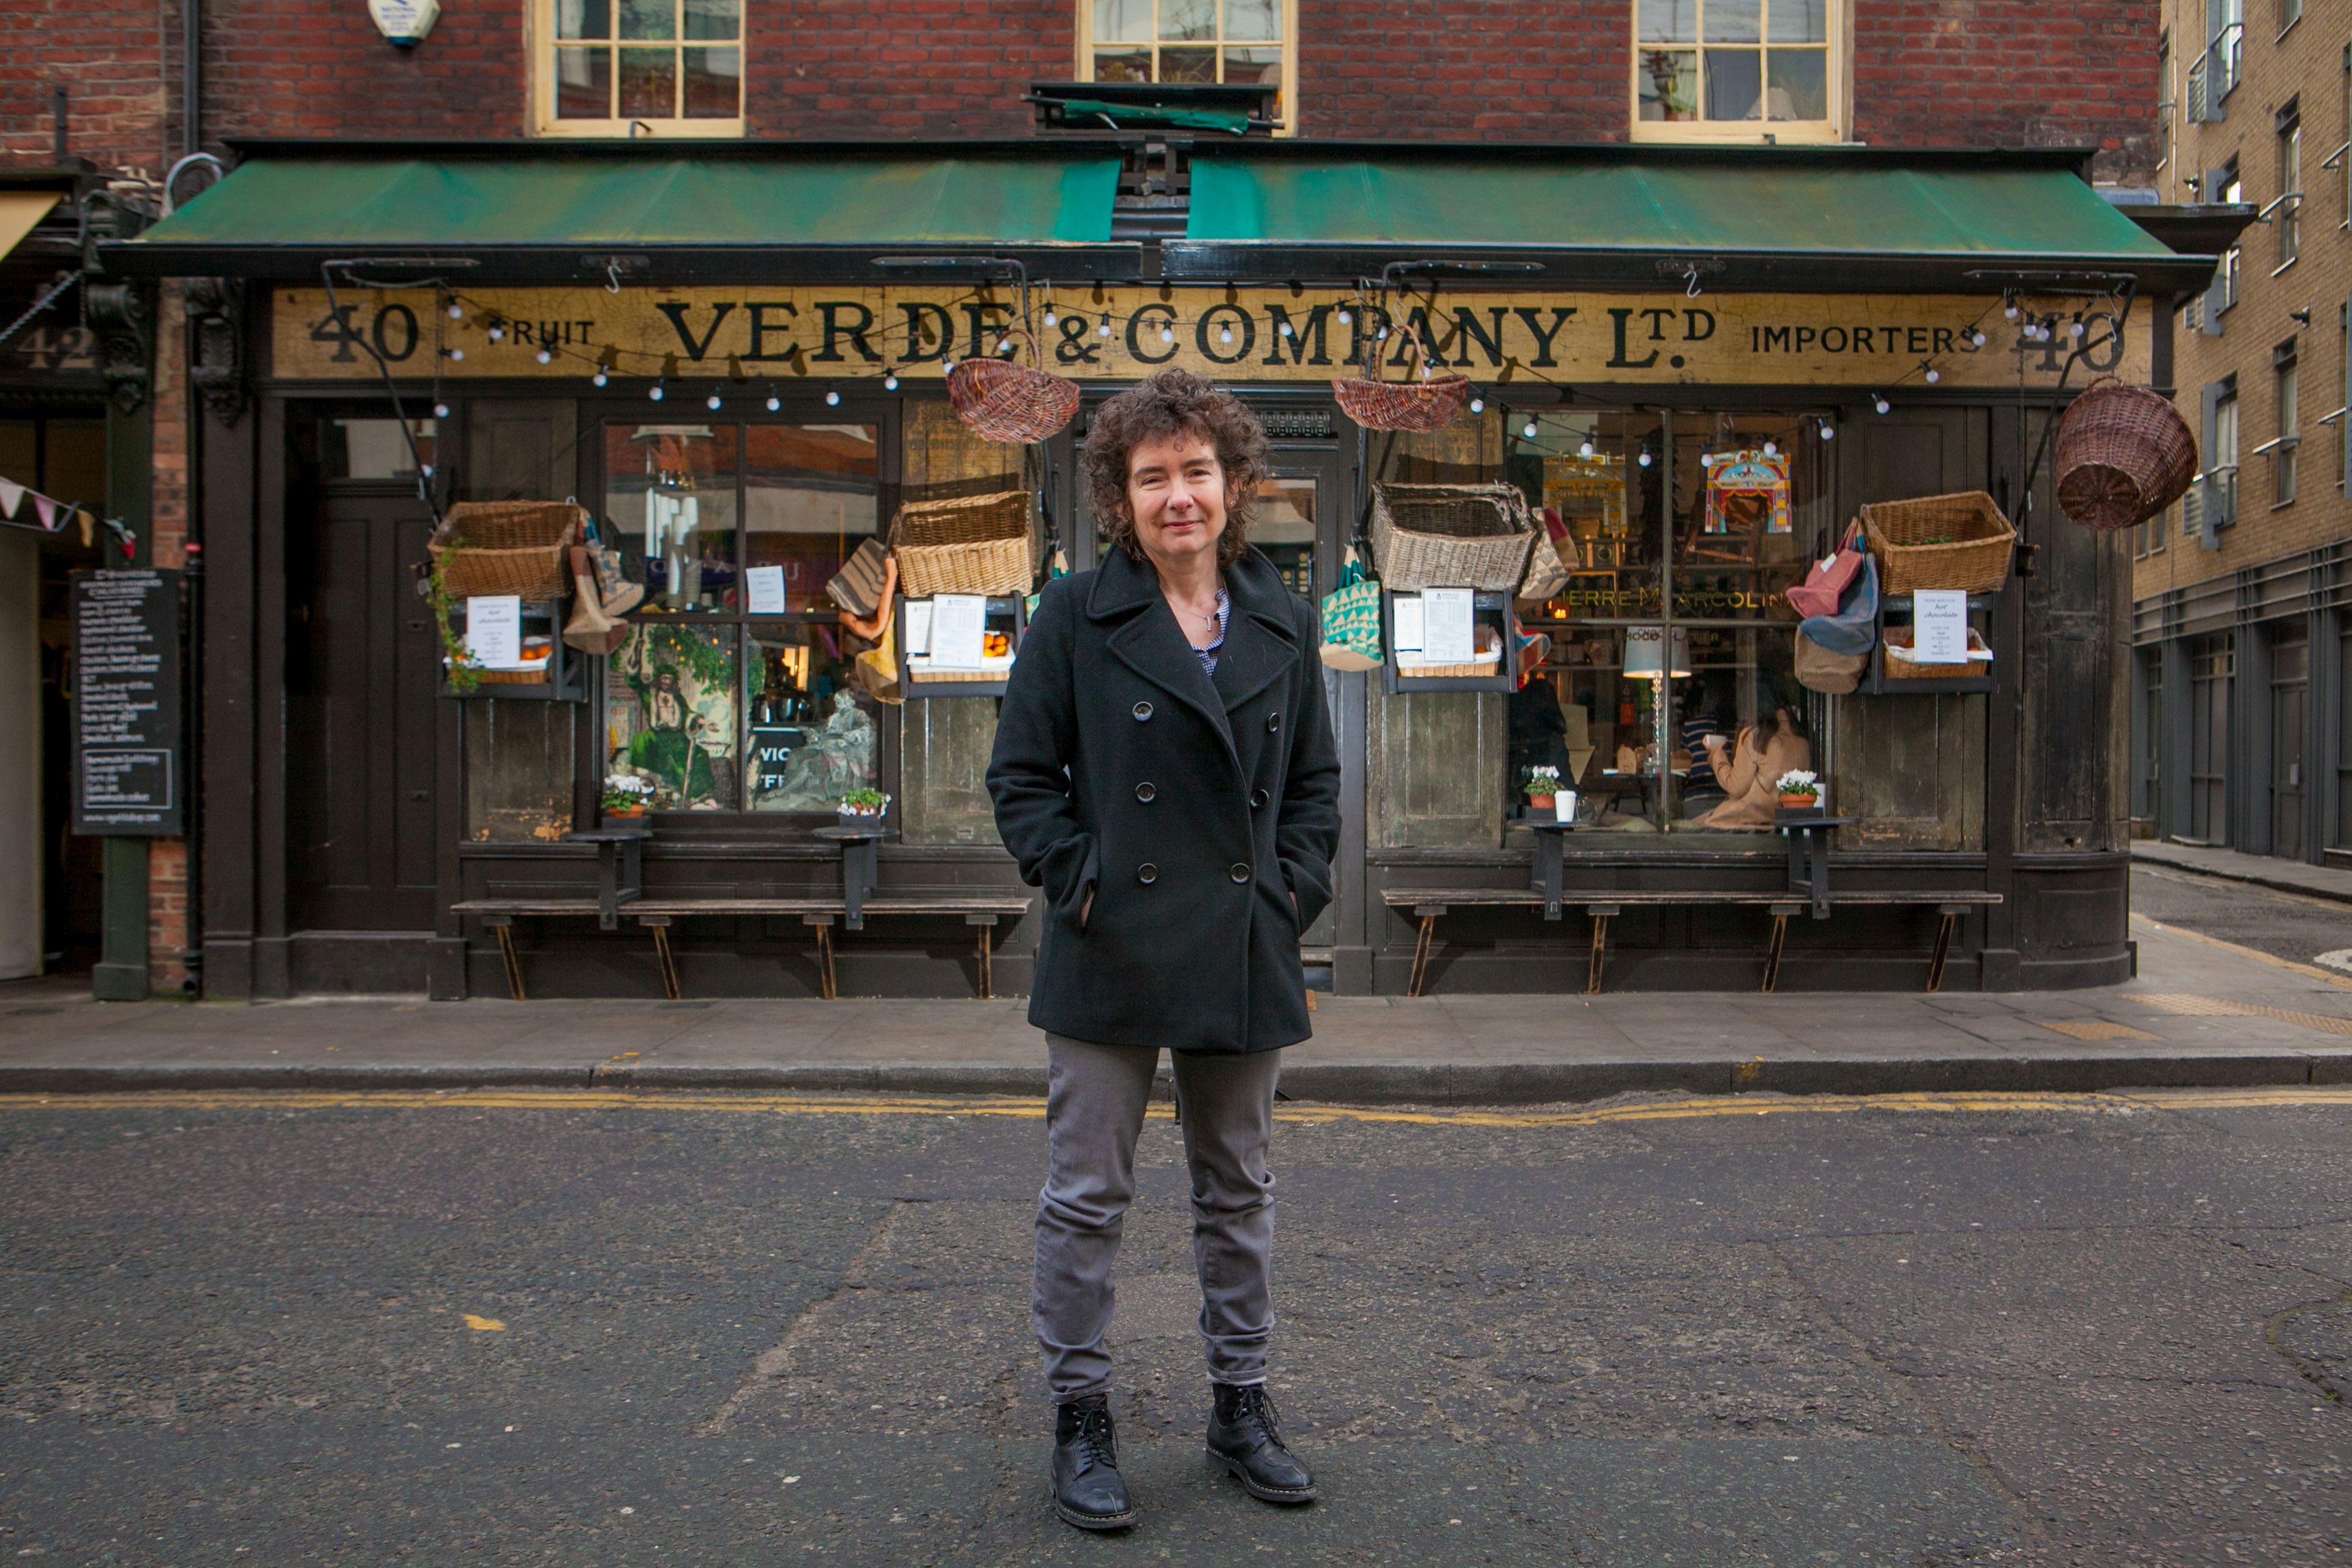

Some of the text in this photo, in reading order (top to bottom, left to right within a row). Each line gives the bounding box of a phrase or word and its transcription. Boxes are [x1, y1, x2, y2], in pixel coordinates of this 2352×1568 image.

[17, 326, 95, 369] 42
[309, 303, 418, 362] 40
[489, 321, 595, 345] FRUIT
[656, 302, 1021, 363] VERDE
[1055, 315, 1101, 364] &
[1125, 303, 1577, 367] COMPANY
[1752, 326, 1981, 354] IMPORTERS
[2015, 312, 2125, 372] 40
